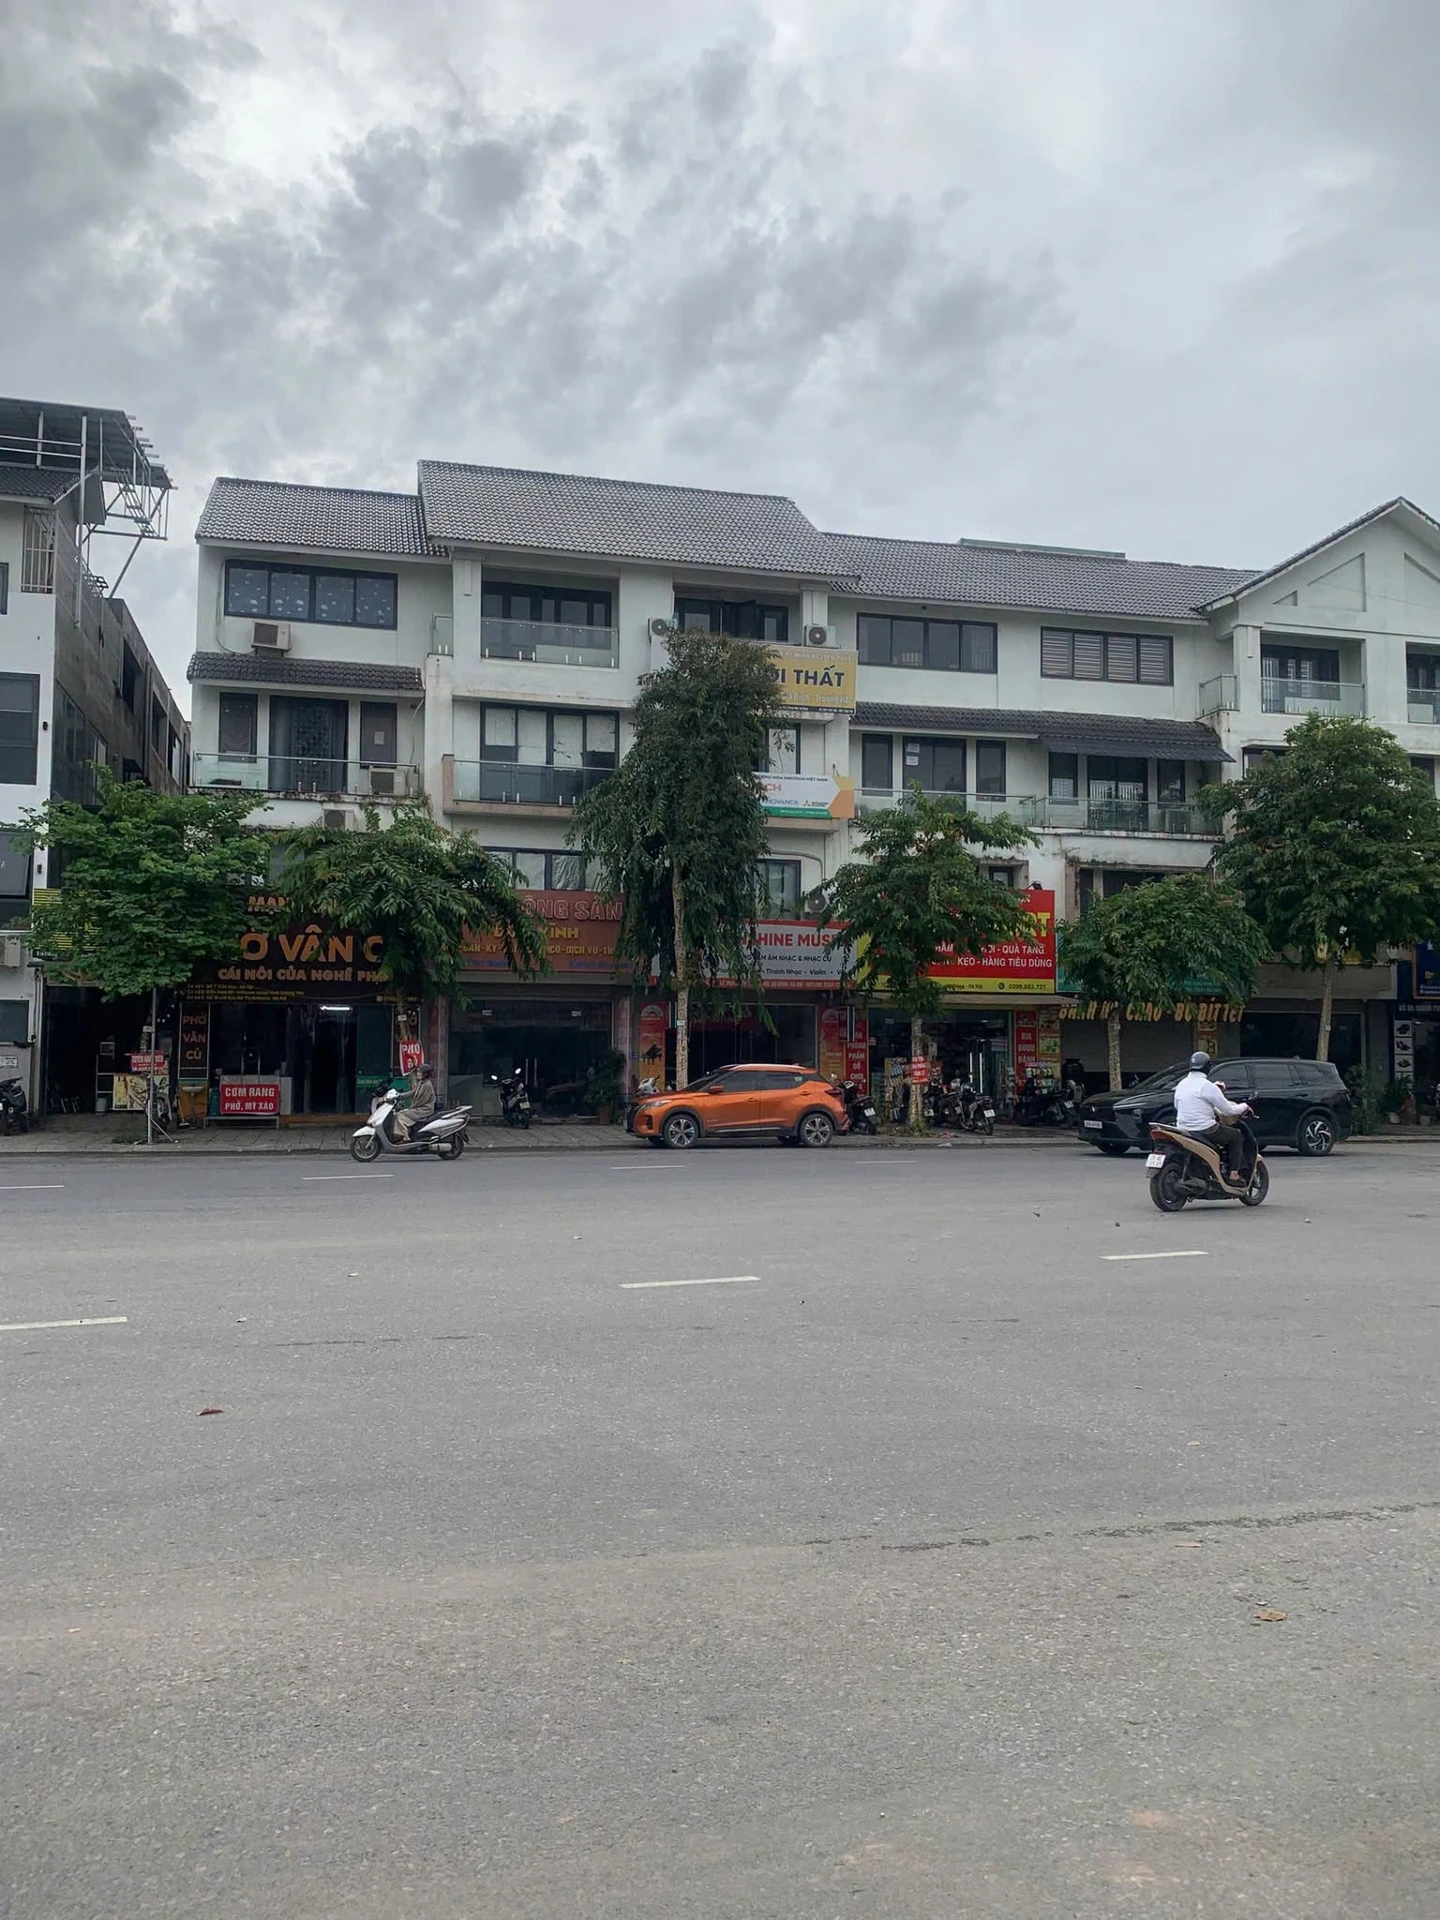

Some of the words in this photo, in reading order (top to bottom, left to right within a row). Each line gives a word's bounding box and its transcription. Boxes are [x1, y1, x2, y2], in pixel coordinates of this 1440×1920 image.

[793, 665, 845, 687] THẤT
[278, 924, 353, 962] VÂN
[1002, 943, 1019, 954] QUÀ
[982, 955, 1006, 968] HÀNG
[1008, 957, 1026, 967] TIÊU
[1028, 957, 1052, 968] DÙNG
[217, 966, 241, 980] CÁI
[276, 965, 306, 981] CỦA
[182, 1031, 206, 1043] VÂN
[225, 1086, 247, 1097] CƠM
[249, 1086, 275, 1097] RANG
